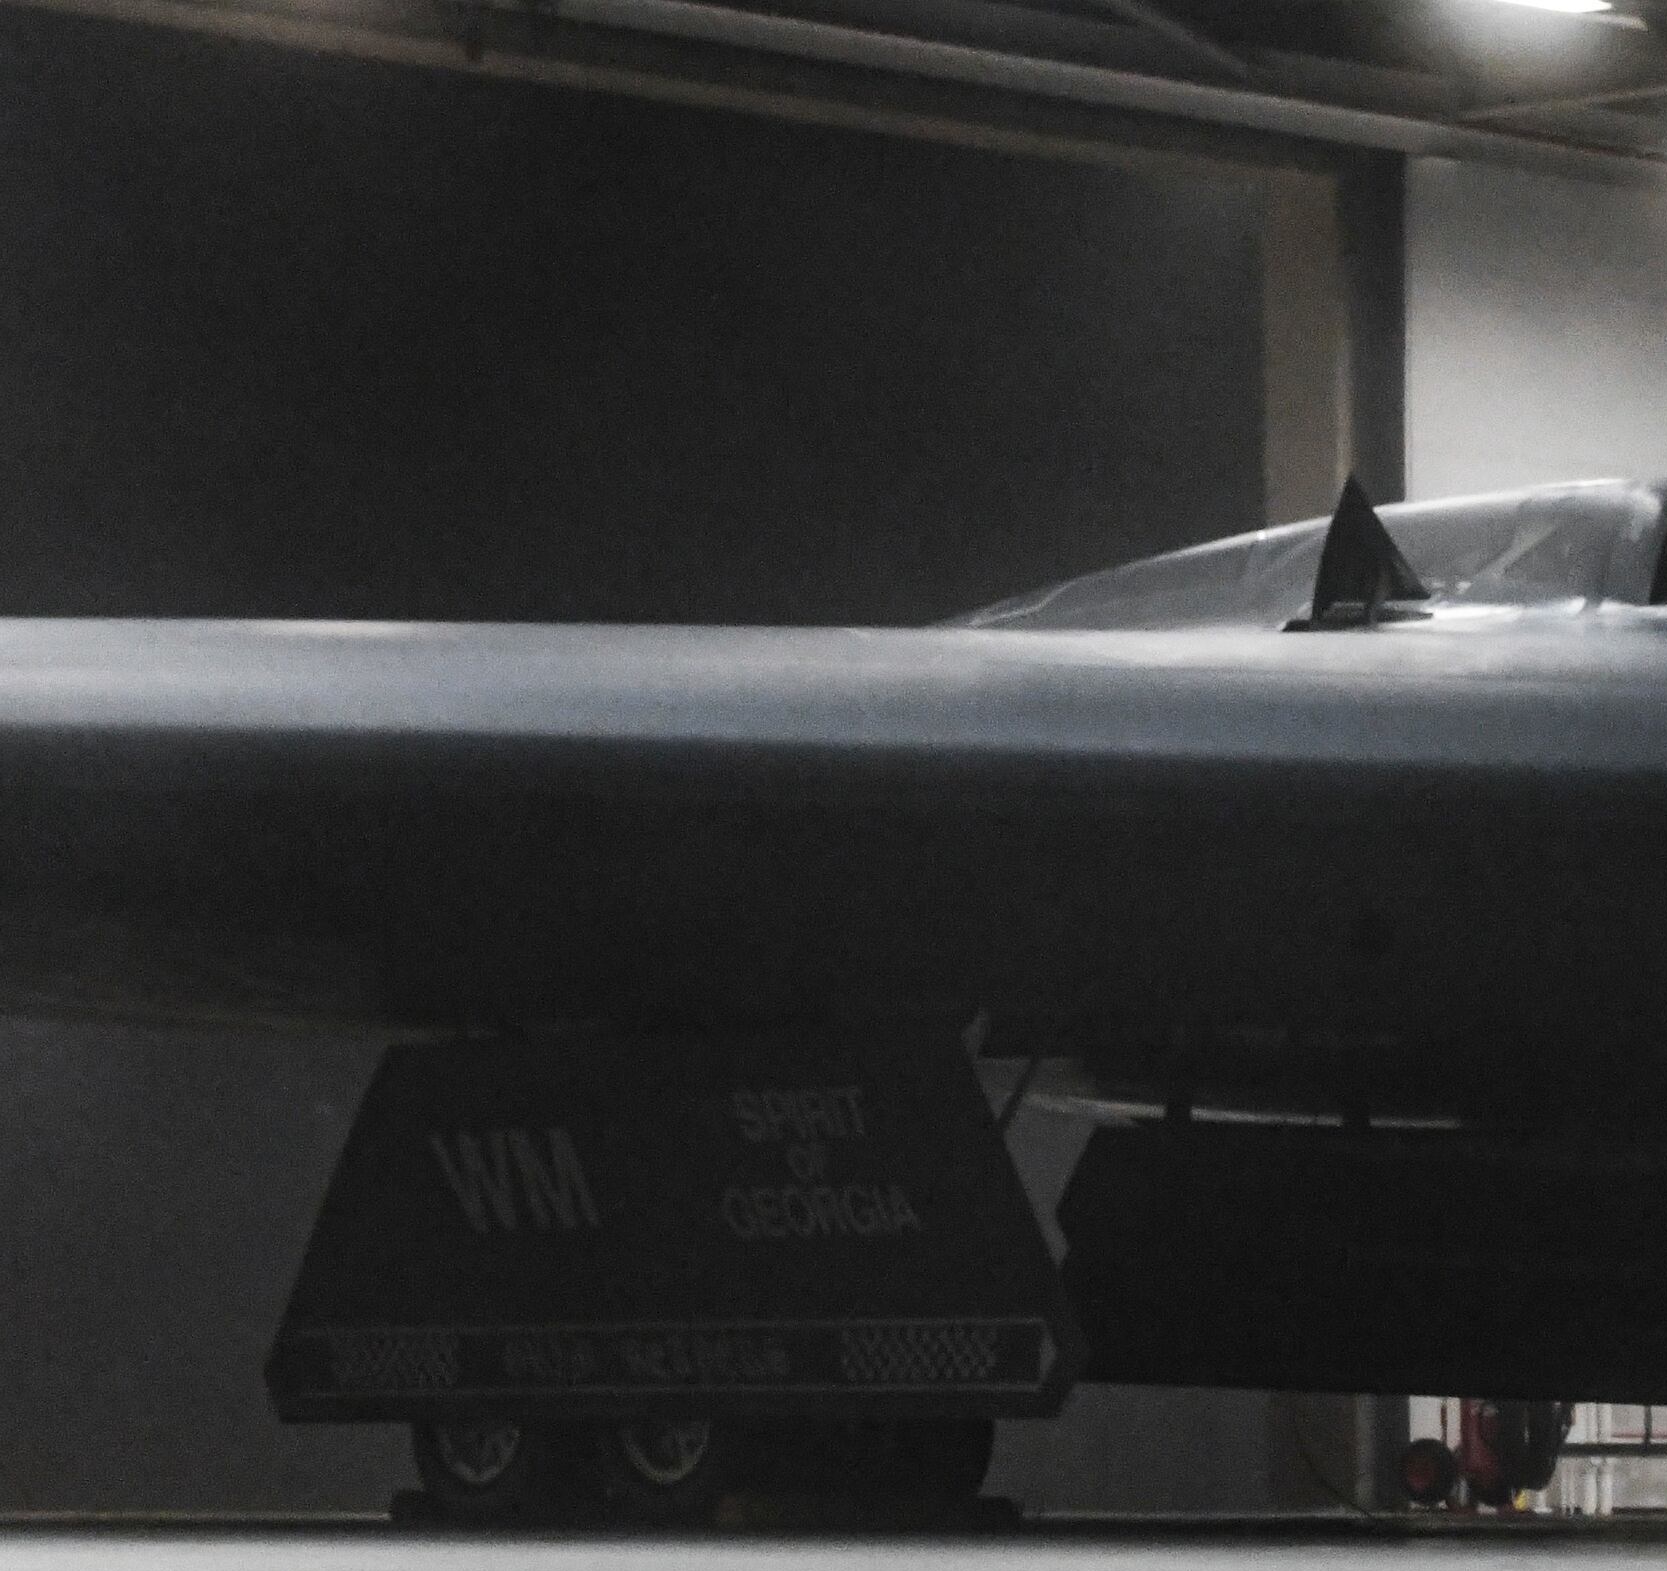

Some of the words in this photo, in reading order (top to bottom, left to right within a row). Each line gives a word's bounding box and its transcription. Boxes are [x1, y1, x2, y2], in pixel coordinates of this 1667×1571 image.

[731, 1089, 867, 1141] SPIRIT
[429, 1127, 601, 1233] WM
[722, 1184, 924, 1238] GEORGIA
